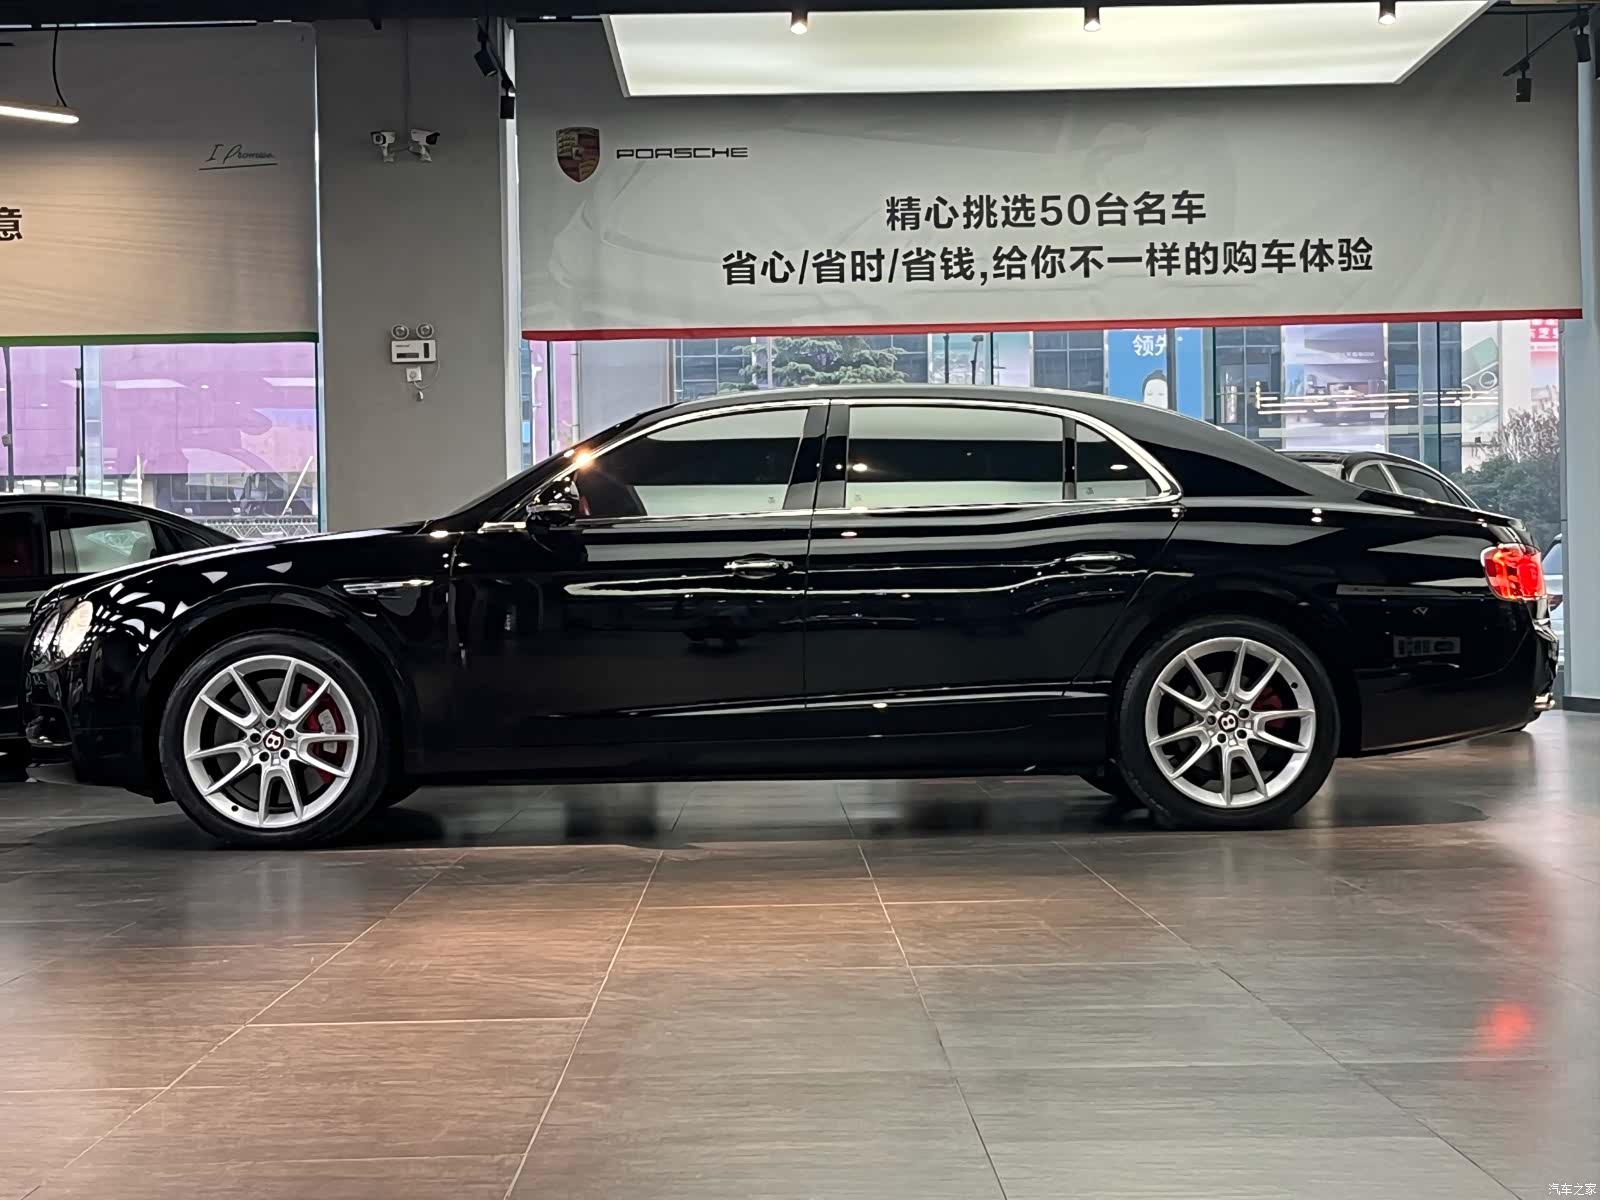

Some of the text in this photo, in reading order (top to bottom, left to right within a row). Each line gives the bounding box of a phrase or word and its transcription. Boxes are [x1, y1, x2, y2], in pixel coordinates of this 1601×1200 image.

[616, 147, 749, 160] PORSCHE
[885, 190, 1207, 231] 精心挑选50台名车
